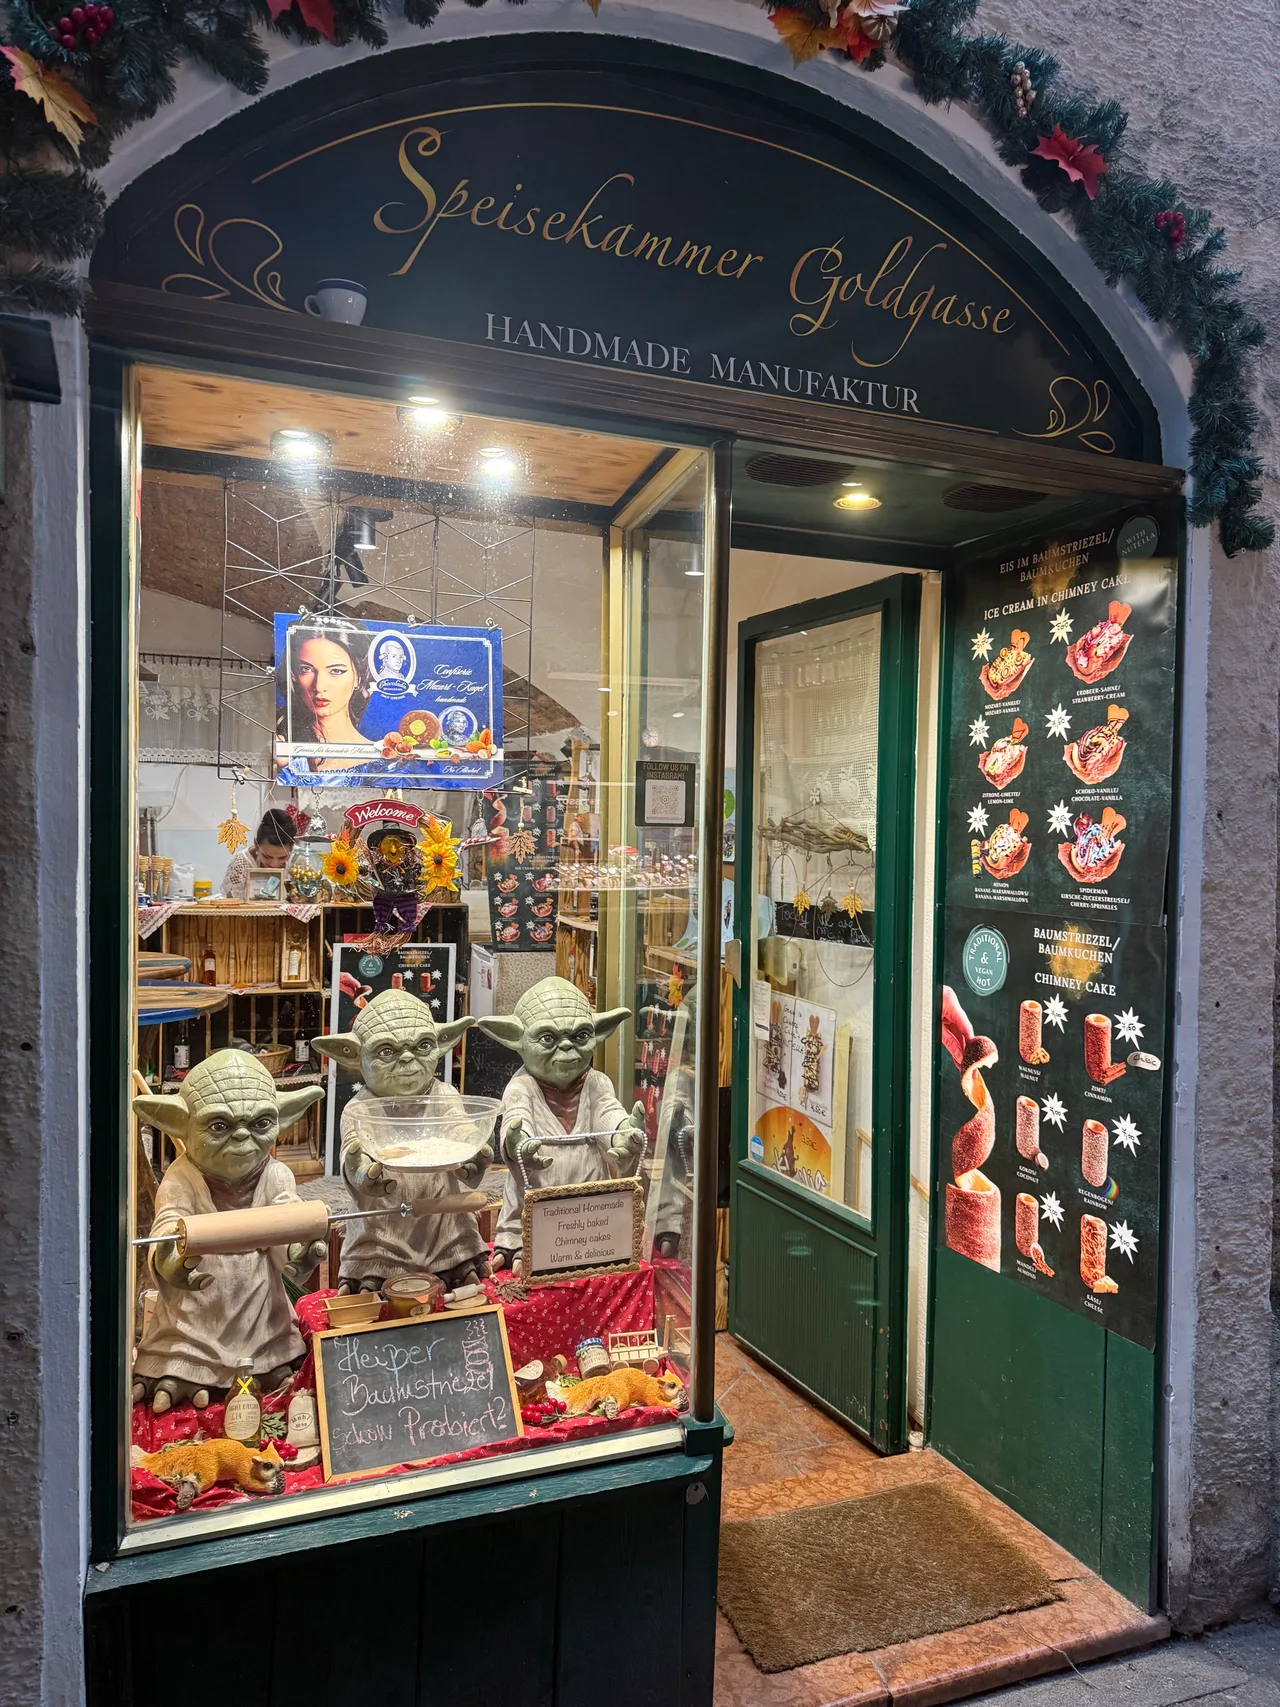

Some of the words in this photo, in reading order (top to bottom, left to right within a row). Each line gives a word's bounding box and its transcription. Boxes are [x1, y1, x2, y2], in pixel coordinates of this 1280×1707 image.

[373, 126, 763, 279] Speisekammer
[789, 236, 1016, 368] Goldgasse
[484, 312, 692, 374] HANDMADE
[709, 353, 921, 413] MANUFAKTUR
[1126, 529, 1146, 545] WITH
[1000, 561, 1015, 574] EIS
[1017, 556, 1029, 569] IM
[1032, 528, 1115, 565] BAUMSTRIEZEL/
[1121, 534, 1156, 556] NUTELLA
[1020, 553, 1090, 582] BAUMKUCHEN
[984, 607, 1000, 620] ICE
[1002, 598, 1034, 615] CREAM
[1037, 595, 1049, 607] IN
[1051, 580, 1099, 603] CHIMNEY
[1071, 692, 1126, 704] STRAWBERRY-CREAM
[643, 763, 669, 771] FOLLOW
[646, 771, 685, 779] INSTAGRAM!
[355, 803, 414, 822] Welcome
[1079, 887, 1108, 895] SPIDERMAN
[1070, 901, 1118, 910] CHERRY-SPRINKLES
[1033, 927, 1121, 951] BAUMSTRIEZEL/
[969, 934, 1003, 963] TRADITIONAL
[1038, 942, 1114, 964] BAUMKUCHEN
[980, 951, 989, 965] &
[975, 966, 993, 976] VEGAN
[976, 976, 991, 987] HOT
[1034, 972, 1082, 991] CHIMNEY
[1085, 981, 1117, 997] CAKE
[1083, 1090, 1113, 1103] CINNAMON
[1016, 1171, 1039, 1184] COCONUT
[542, 1203, 581, 1217] Traditional
[583, 1198, 625, 1213] Homemade
[1083, 1197, 1108, 1210] RAINBOW
[557, 1219, 585, 1231] Freshly
[586, 1216, 609, 1228] baked
[554, 1235, 587, 1247] Chimney
[589, 1232, 611, 1243] cakes
[550, 1253, 573, 1263] Warm
[574, 1250, 583, 1260] &
[584, 1248, 616, 1259] delicious
[1083, 1300, 1104, 1315] CHEESE
[342, 1361, 494, 1416] Baumstriezel
[291, 1414, 312, 1424] Mehl
